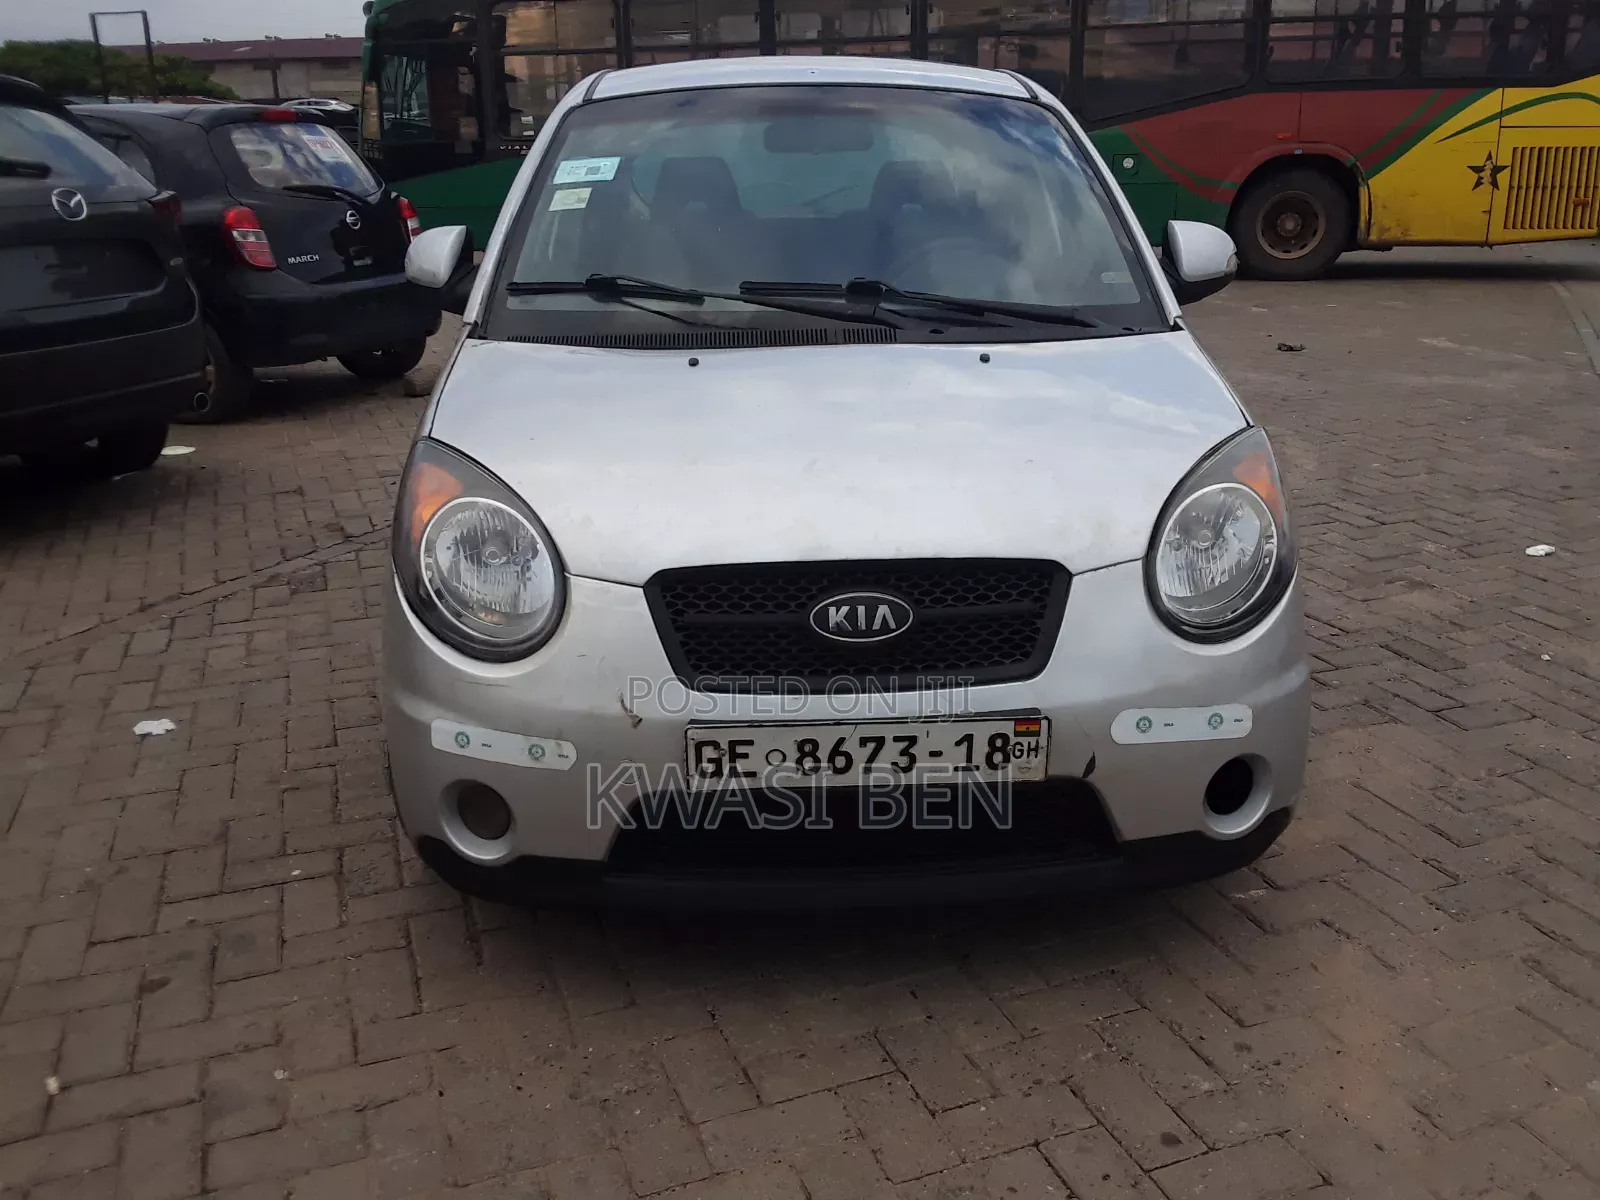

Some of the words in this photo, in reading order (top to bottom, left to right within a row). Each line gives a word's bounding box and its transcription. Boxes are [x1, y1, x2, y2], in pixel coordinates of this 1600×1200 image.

[287, 254, 320, 265] MARCH
[827, 605, 897, 631] KIA
[694, 739, 758, 779] GE
[795, 731, 1011, 776] 8673-18
[1012, 738, 1039, 760] GH
